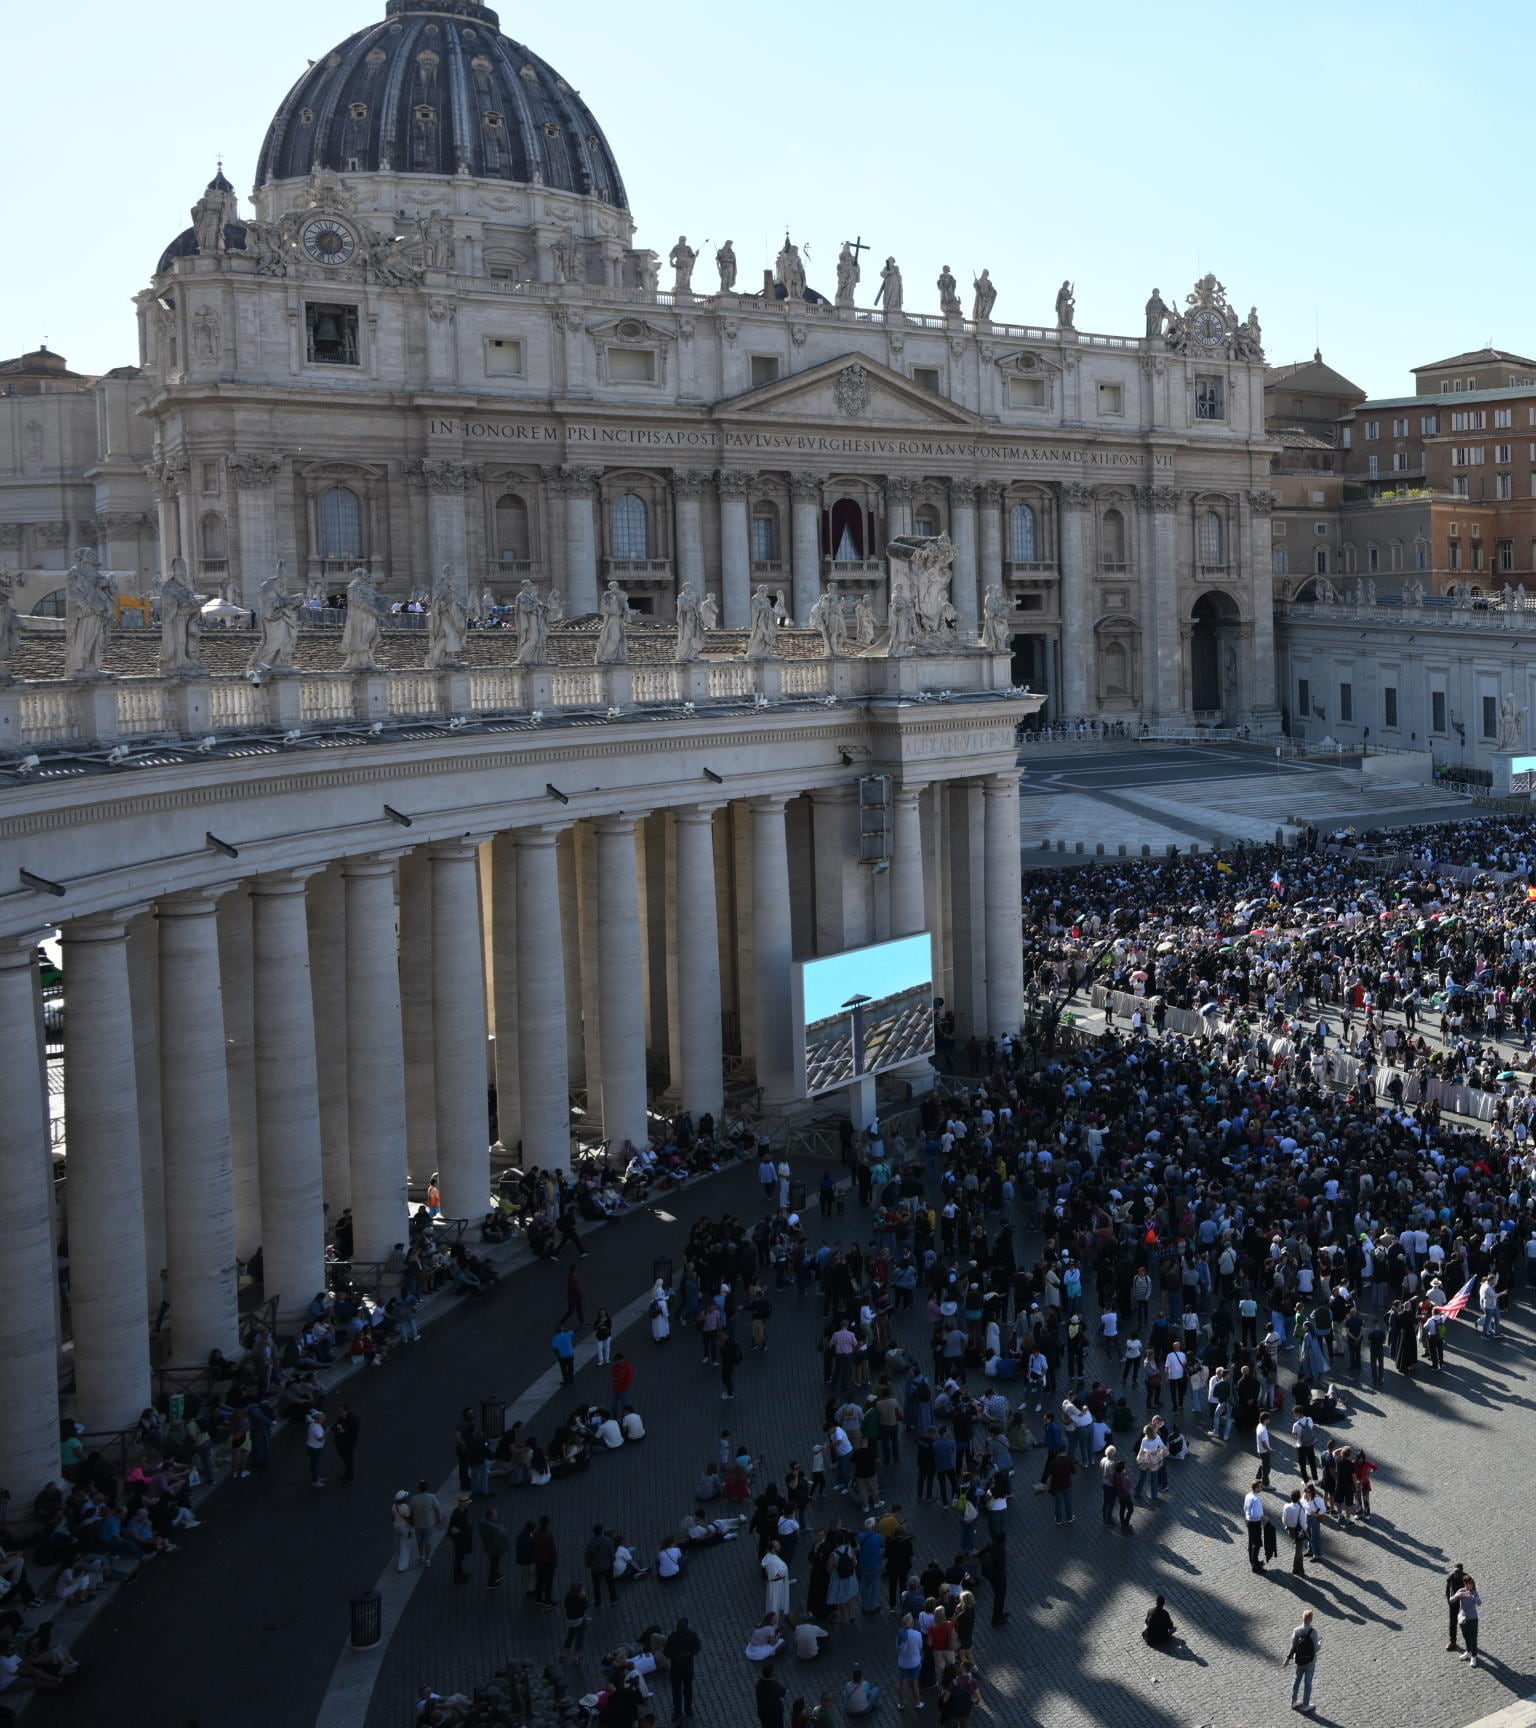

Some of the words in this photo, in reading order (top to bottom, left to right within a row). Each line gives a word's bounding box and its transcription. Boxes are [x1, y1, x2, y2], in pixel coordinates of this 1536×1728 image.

[429, 420, 453, 434] IN
[567, 427, 661, 444] PRINCIPIS
[664, 431, 717, 446] APOST
[725, 433, 782, 448] PAVLVS
[783, 434, 793, 448] V
[797, 436, 895, 453] BVRGHESIVS
[899, 441, 973, 456] ROMANVS
[973, 446, 1009, 459] PONT
[1009, 447, 1040, 460] MAX
[1041, 448, 1060, 461] AN
[1113, 454, 1147, 466] PONT
[1154, 455, 1173, 466] VII
[905, 735, 958, 756] ALEXAN
[962, 733, 984, 751] VII
